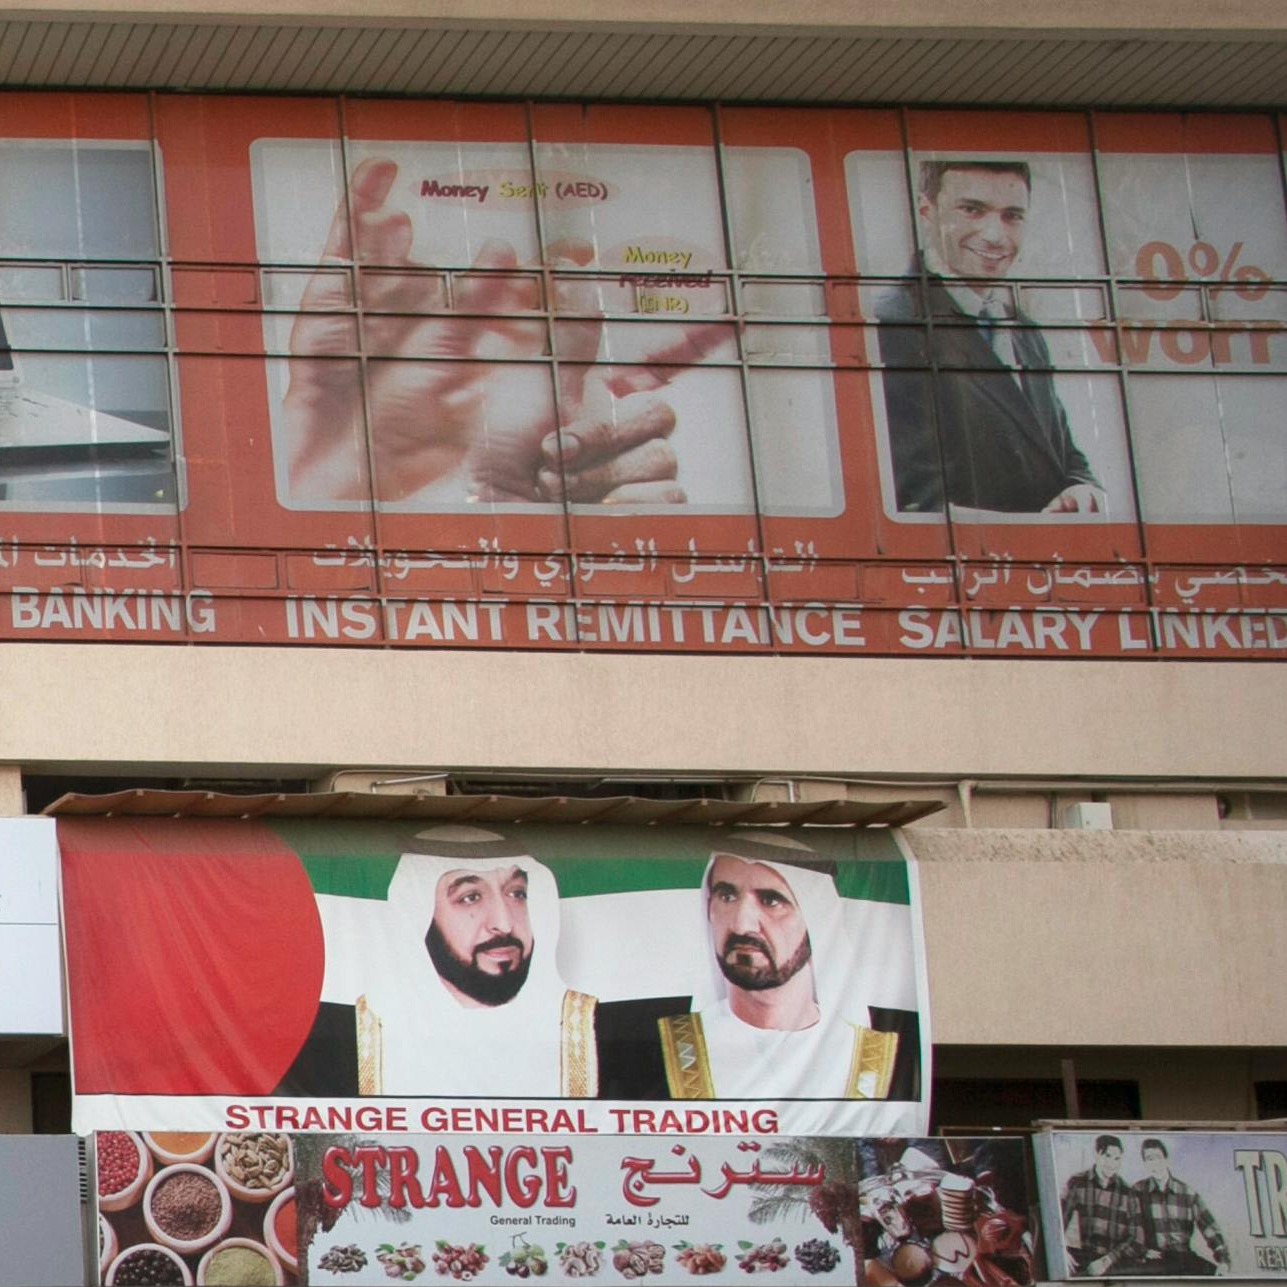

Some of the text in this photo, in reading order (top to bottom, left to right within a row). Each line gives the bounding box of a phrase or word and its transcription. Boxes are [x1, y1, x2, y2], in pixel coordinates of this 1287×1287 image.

[420, 180, 489, 202] Money
[555, 182, 608, 200] (AED)
[625, 245, 693, 268] Money
[1135, 241, 1273, 302] 0%
[619, 268, 713, 289] received
[34, 535, 176, 569] الخدمات
[11, 585, 216, 634] BANKING
[285, 593, 866, 647] INSTANT REMITTANCE
[898, 605, 1287, 650] SALARY LINKED
[225, 1104, 779, 1134] STRANGE GENERAL TRADING
[321, 1145, 577, 1209] STRANGE
[621, 1141, 825, 1208] سترنج
[490, 1215, 577, 1228] General Trading
[606, 1213, 643, 1227] العامة
[1255, 1246, 1287, 1271] REA
